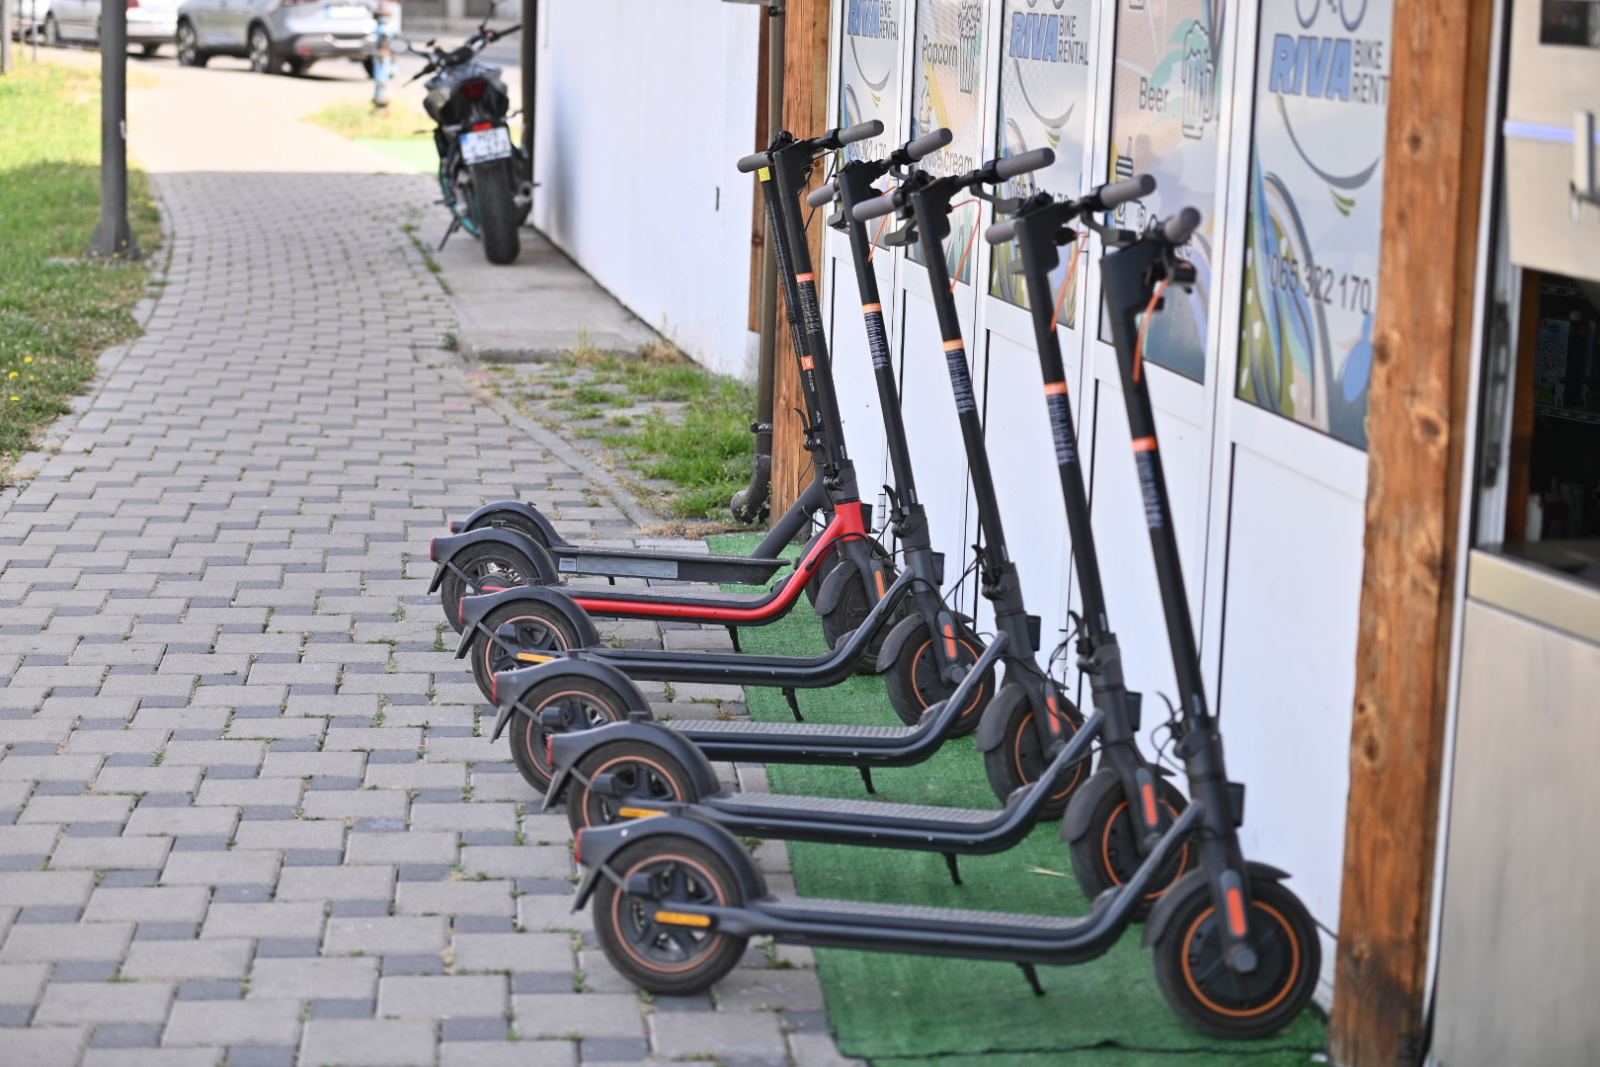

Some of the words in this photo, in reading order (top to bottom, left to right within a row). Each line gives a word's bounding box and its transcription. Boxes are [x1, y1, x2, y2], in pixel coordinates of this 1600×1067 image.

[847, 0, 880, 38] RIVA
[879, 0, 892, 18] BIKE
[879, 20, 899, 40] RENTAL
[1008, 11, 1059, 63] RIVA
[1059, 14, 1077, 38] BIKE
[922, 34, 958, 71] Popcorn
[1057, 39, 1089, 66] RENTAL
[1268, 33, 1352, 102] RIVA
[1353, 39, 1383, 69] BIKE
[1138, 76, 1169, 113] Beer
[944, 150, 973, 176] cream
[1270, 255, 1298, 293] 065
[1339, 273, 1373, 315] 170
